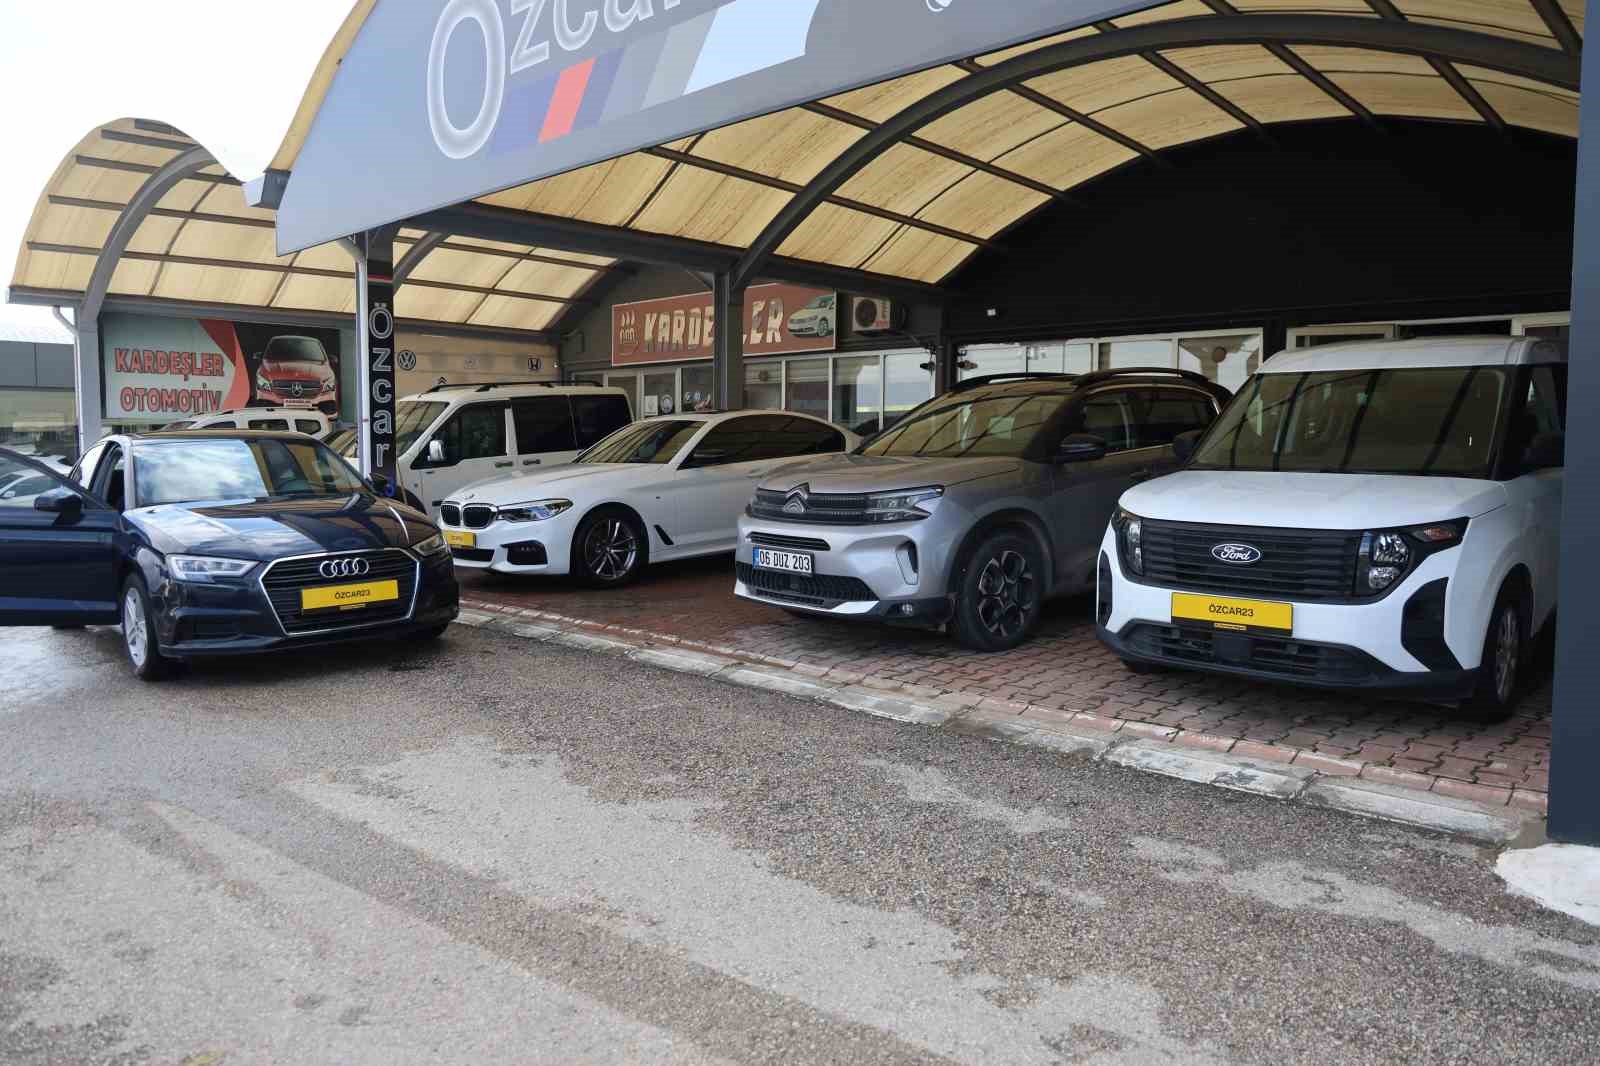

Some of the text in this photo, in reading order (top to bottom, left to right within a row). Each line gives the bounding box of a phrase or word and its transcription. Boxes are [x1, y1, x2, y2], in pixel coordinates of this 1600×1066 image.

[114, 347, 224, 381] KARDEŞLER
[369, 302, 393, 467] Özcar
[120, 382, 222, 414] OTOMOTİV
[760, 551, 809, 570] 06 DUZ 203
[1221, 545, 1250, 560] Ford
[335, 589, 370, 599] ÖZCAR23
[1209, 603, 1253, 616] ÖZCAR23
